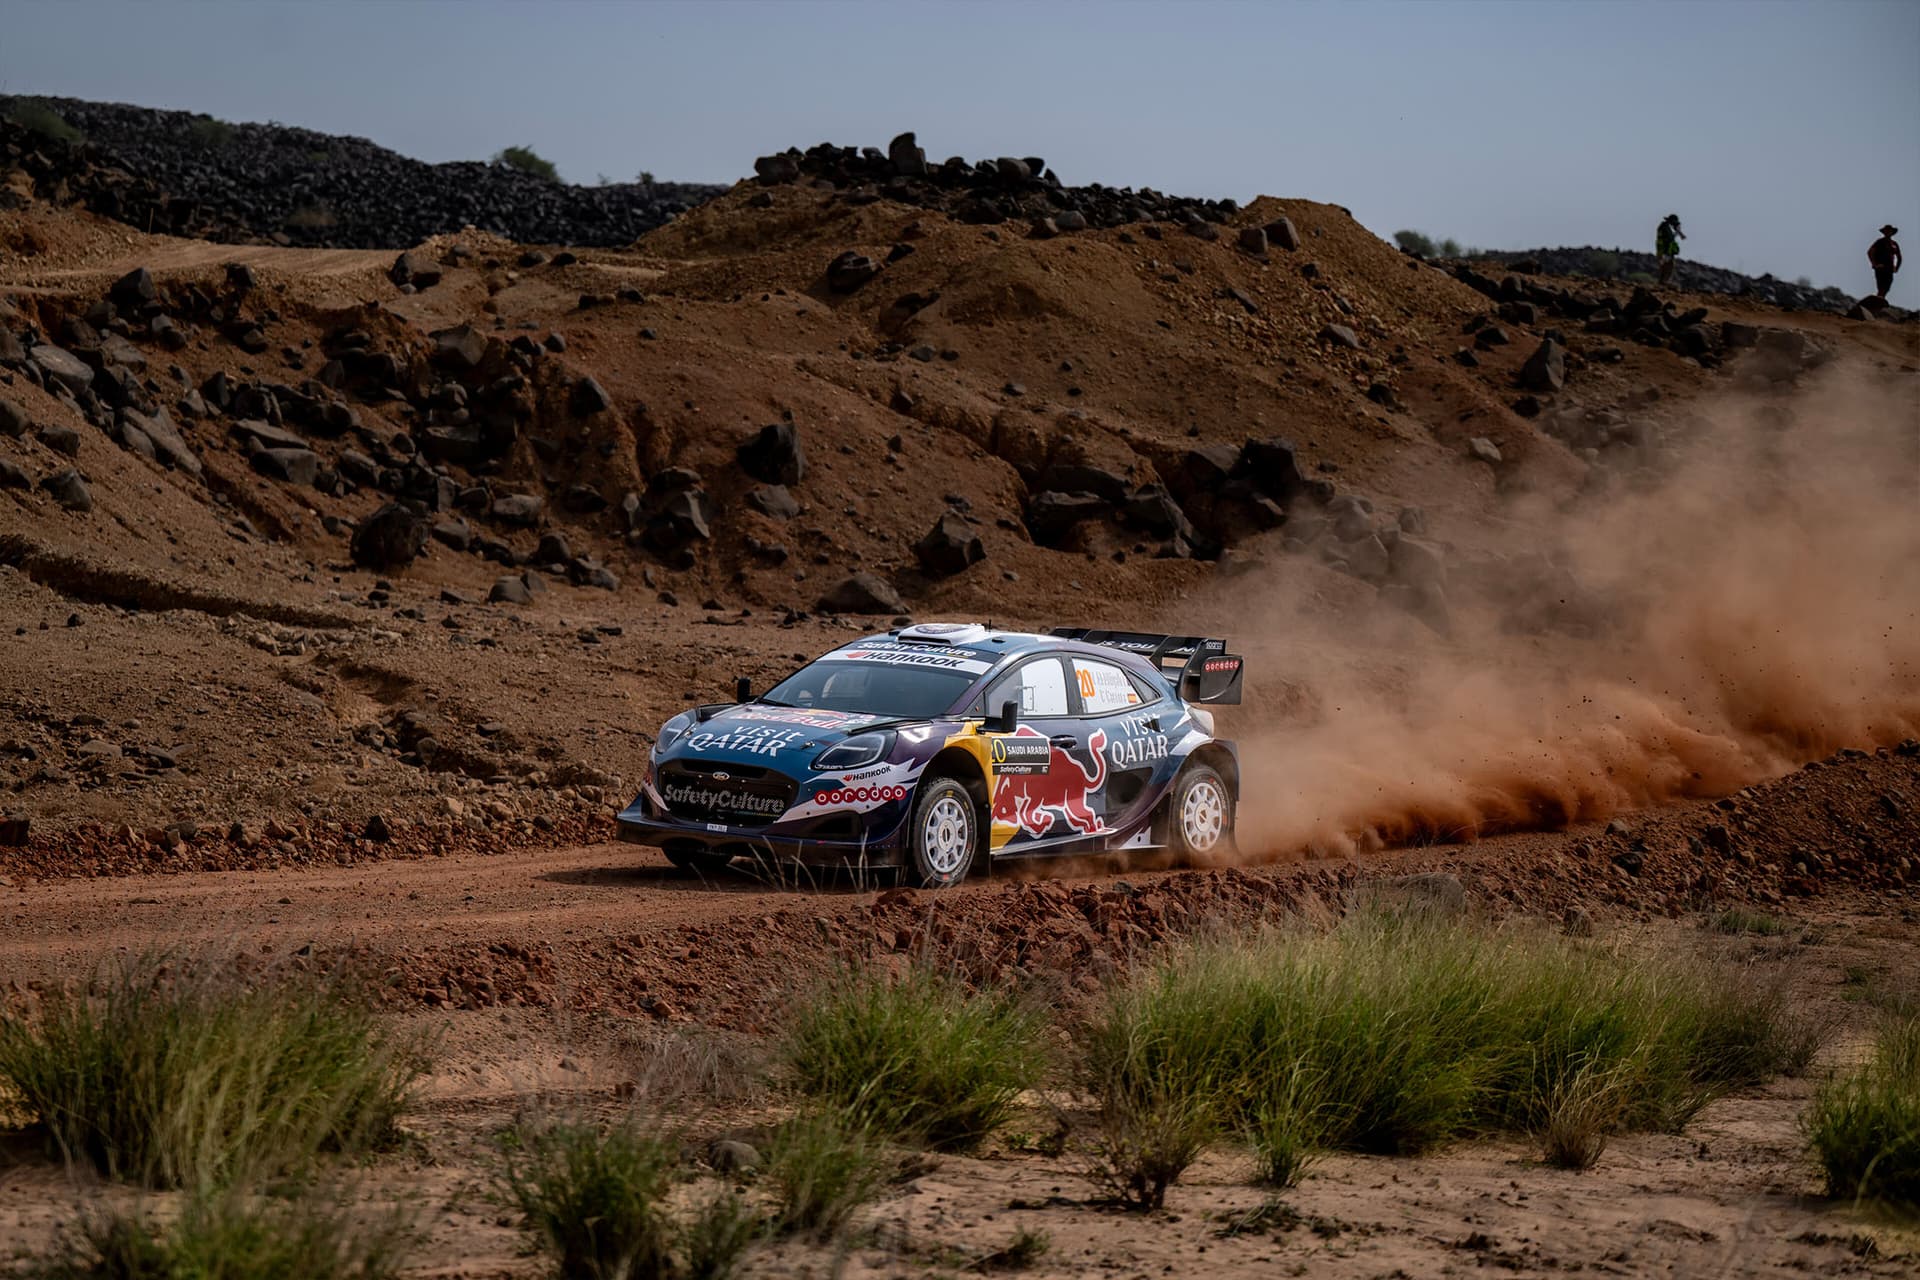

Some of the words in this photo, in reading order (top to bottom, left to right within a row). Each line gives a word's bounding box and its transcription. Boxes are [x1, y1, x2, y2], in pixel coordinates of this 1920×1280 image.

[864, 651, 964, 667] Hankook
[1076, 669, 1095, 697] 20
[734, 725, 804, 742] visit
[688, 733, 786, 757] QATAR
[991, 739, 1006, 763] 0
[1007, 745, 1026, 755] SAUDI
[1027, 745, 1049, 755] ARABIA
[1112, 735, 1168, 768] QATAR
[853, 766, 891, 780] Hankook
[664, 783, 785, 813] SafetyCulture
[815, 786, 906, 805] ooredoo
